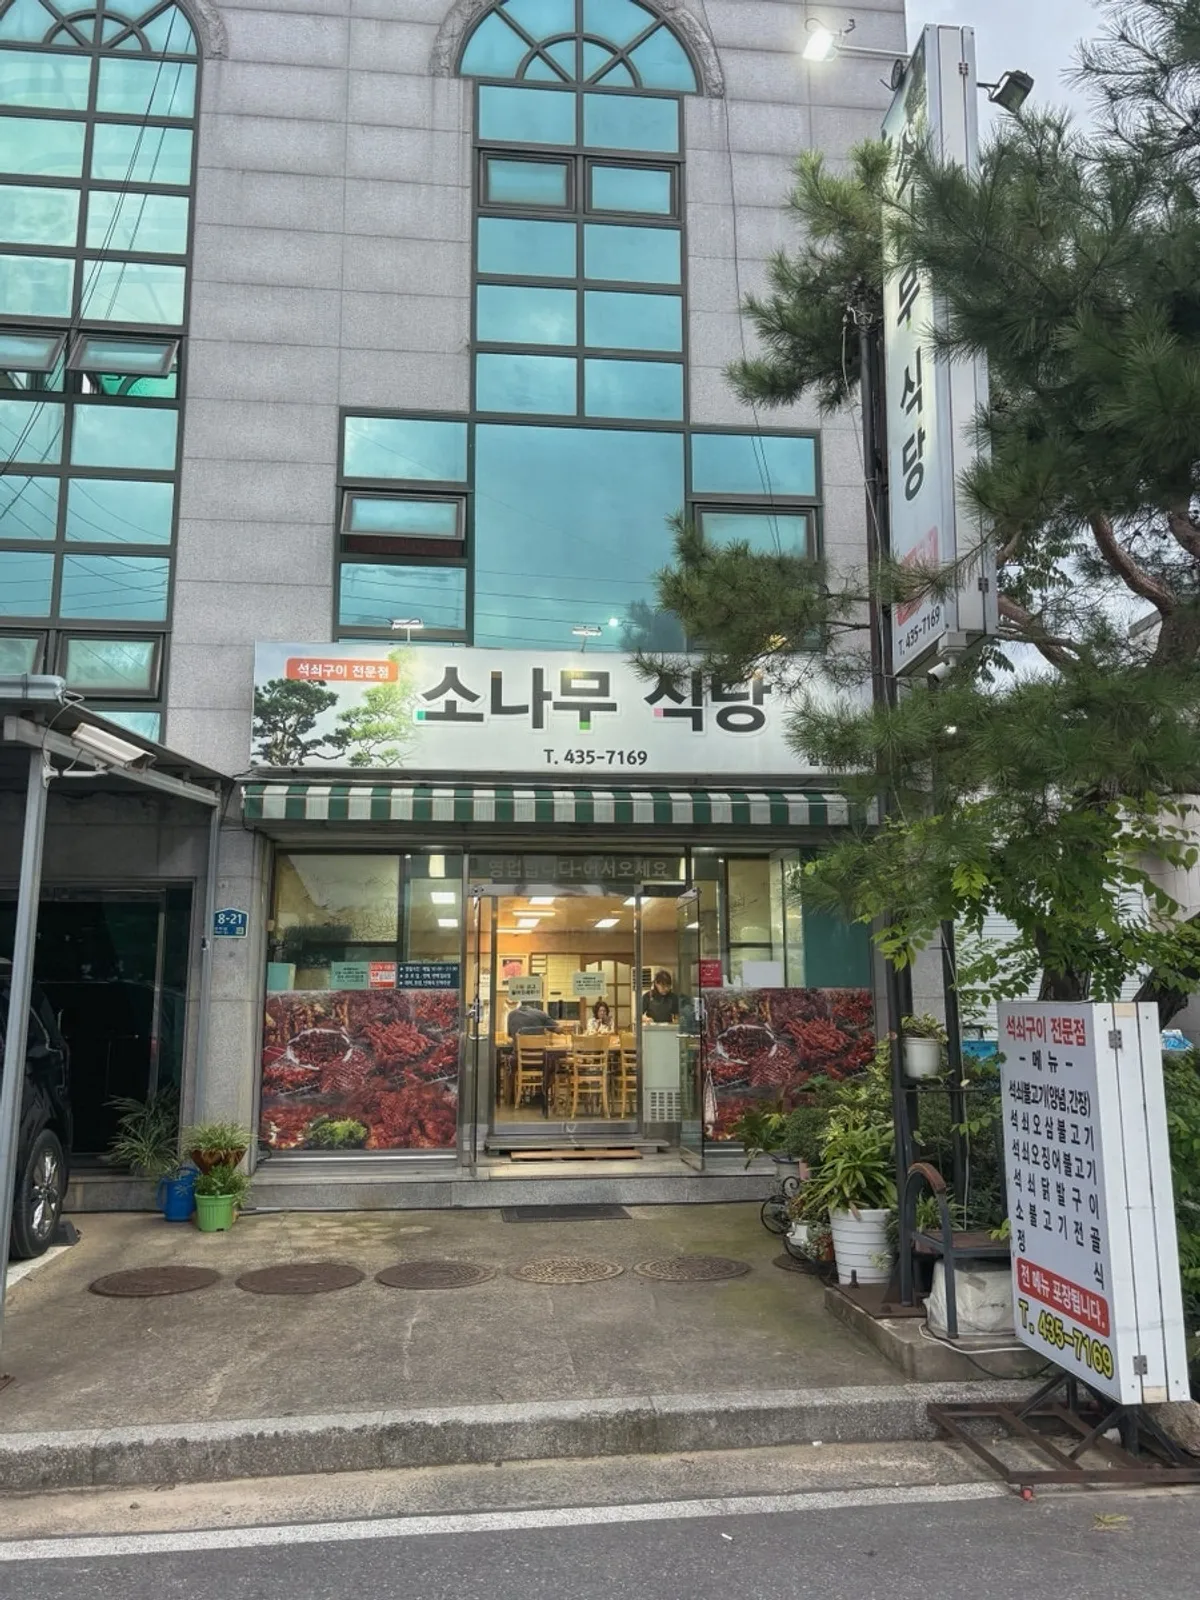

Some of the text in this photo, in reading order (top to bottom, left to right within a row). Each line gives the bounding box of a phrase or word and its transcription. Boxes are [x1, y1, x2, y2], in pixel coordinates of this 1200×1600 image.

[900, 346, 926, 501] 식당
[905, 606, 939, 647] 435-7169
[298, 663, 347, 677] 석쇠구이
[417, 667, 772, 733] 소나무 식당
[544, 748, 648, 765] T. 435-7169
[218, 913, 242, 924] 8-21
[1006, 1015, 1086, 1046] 석쇠구이 전문점
[1021, 1264, 1105, 1328] 전 메뉴 포장됩니다.
[1018, 1298, 1115, 1380] T. 435-7169
